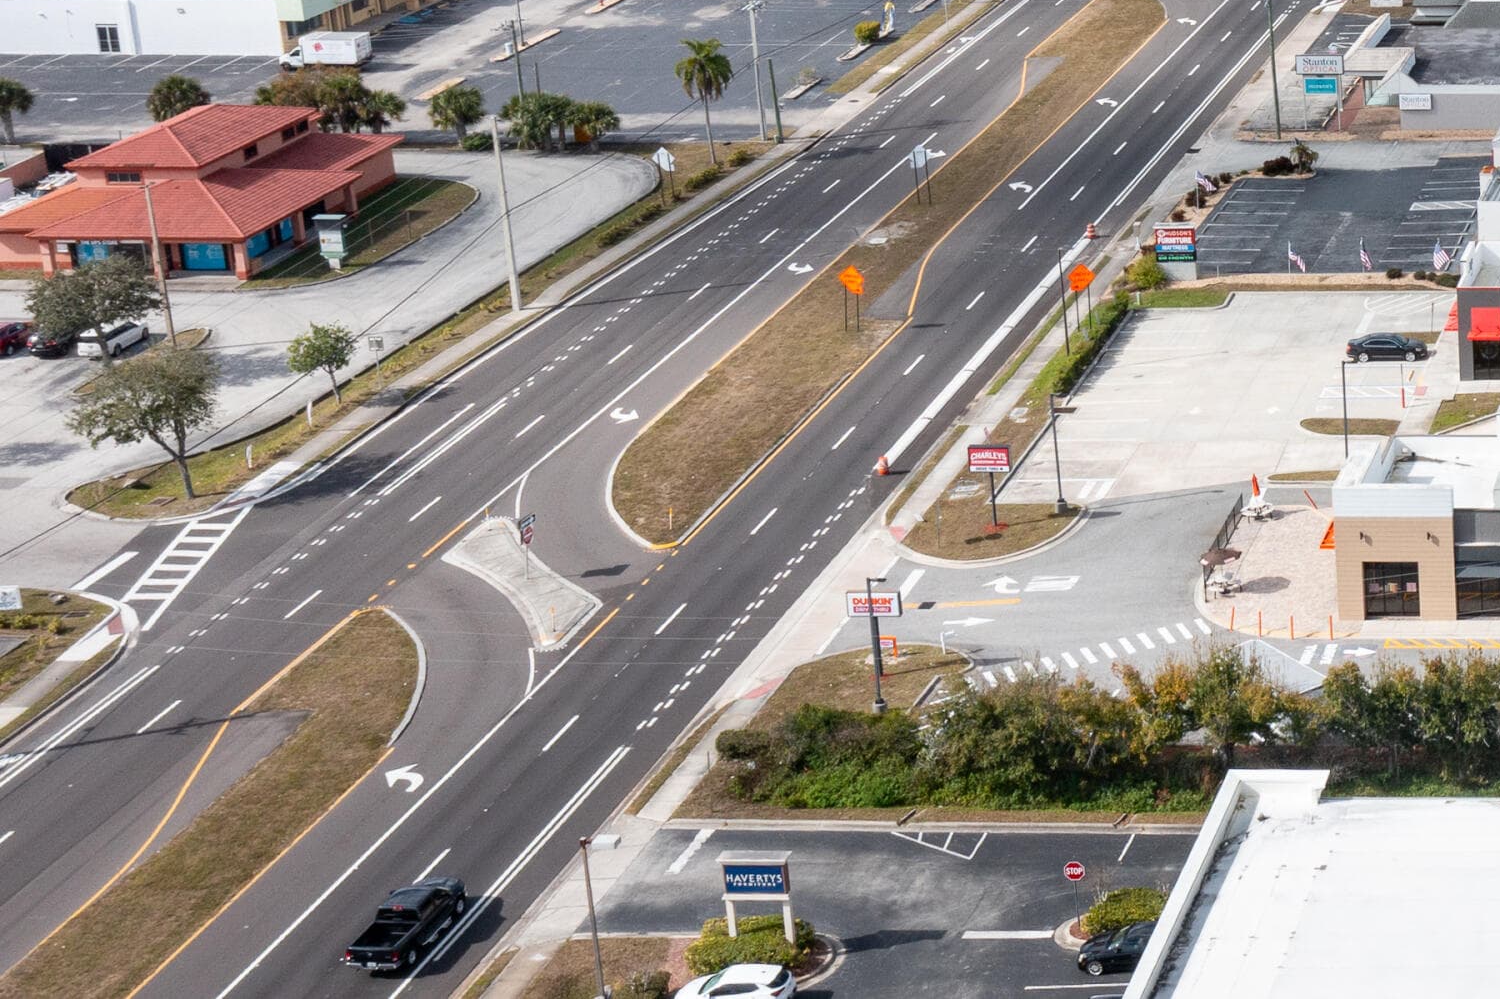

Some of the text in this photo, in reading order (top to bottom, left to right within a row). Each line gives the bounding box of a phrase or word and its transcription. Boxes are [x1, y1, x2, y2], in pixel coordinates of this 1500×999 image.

[1302, 57, 1338, 66] Stanton
[970, 451, 1007, 460] CHARLEYS
[1065, 867, 1083, 875] STOP
[726, 874, 783, 883] HAVERTYS
